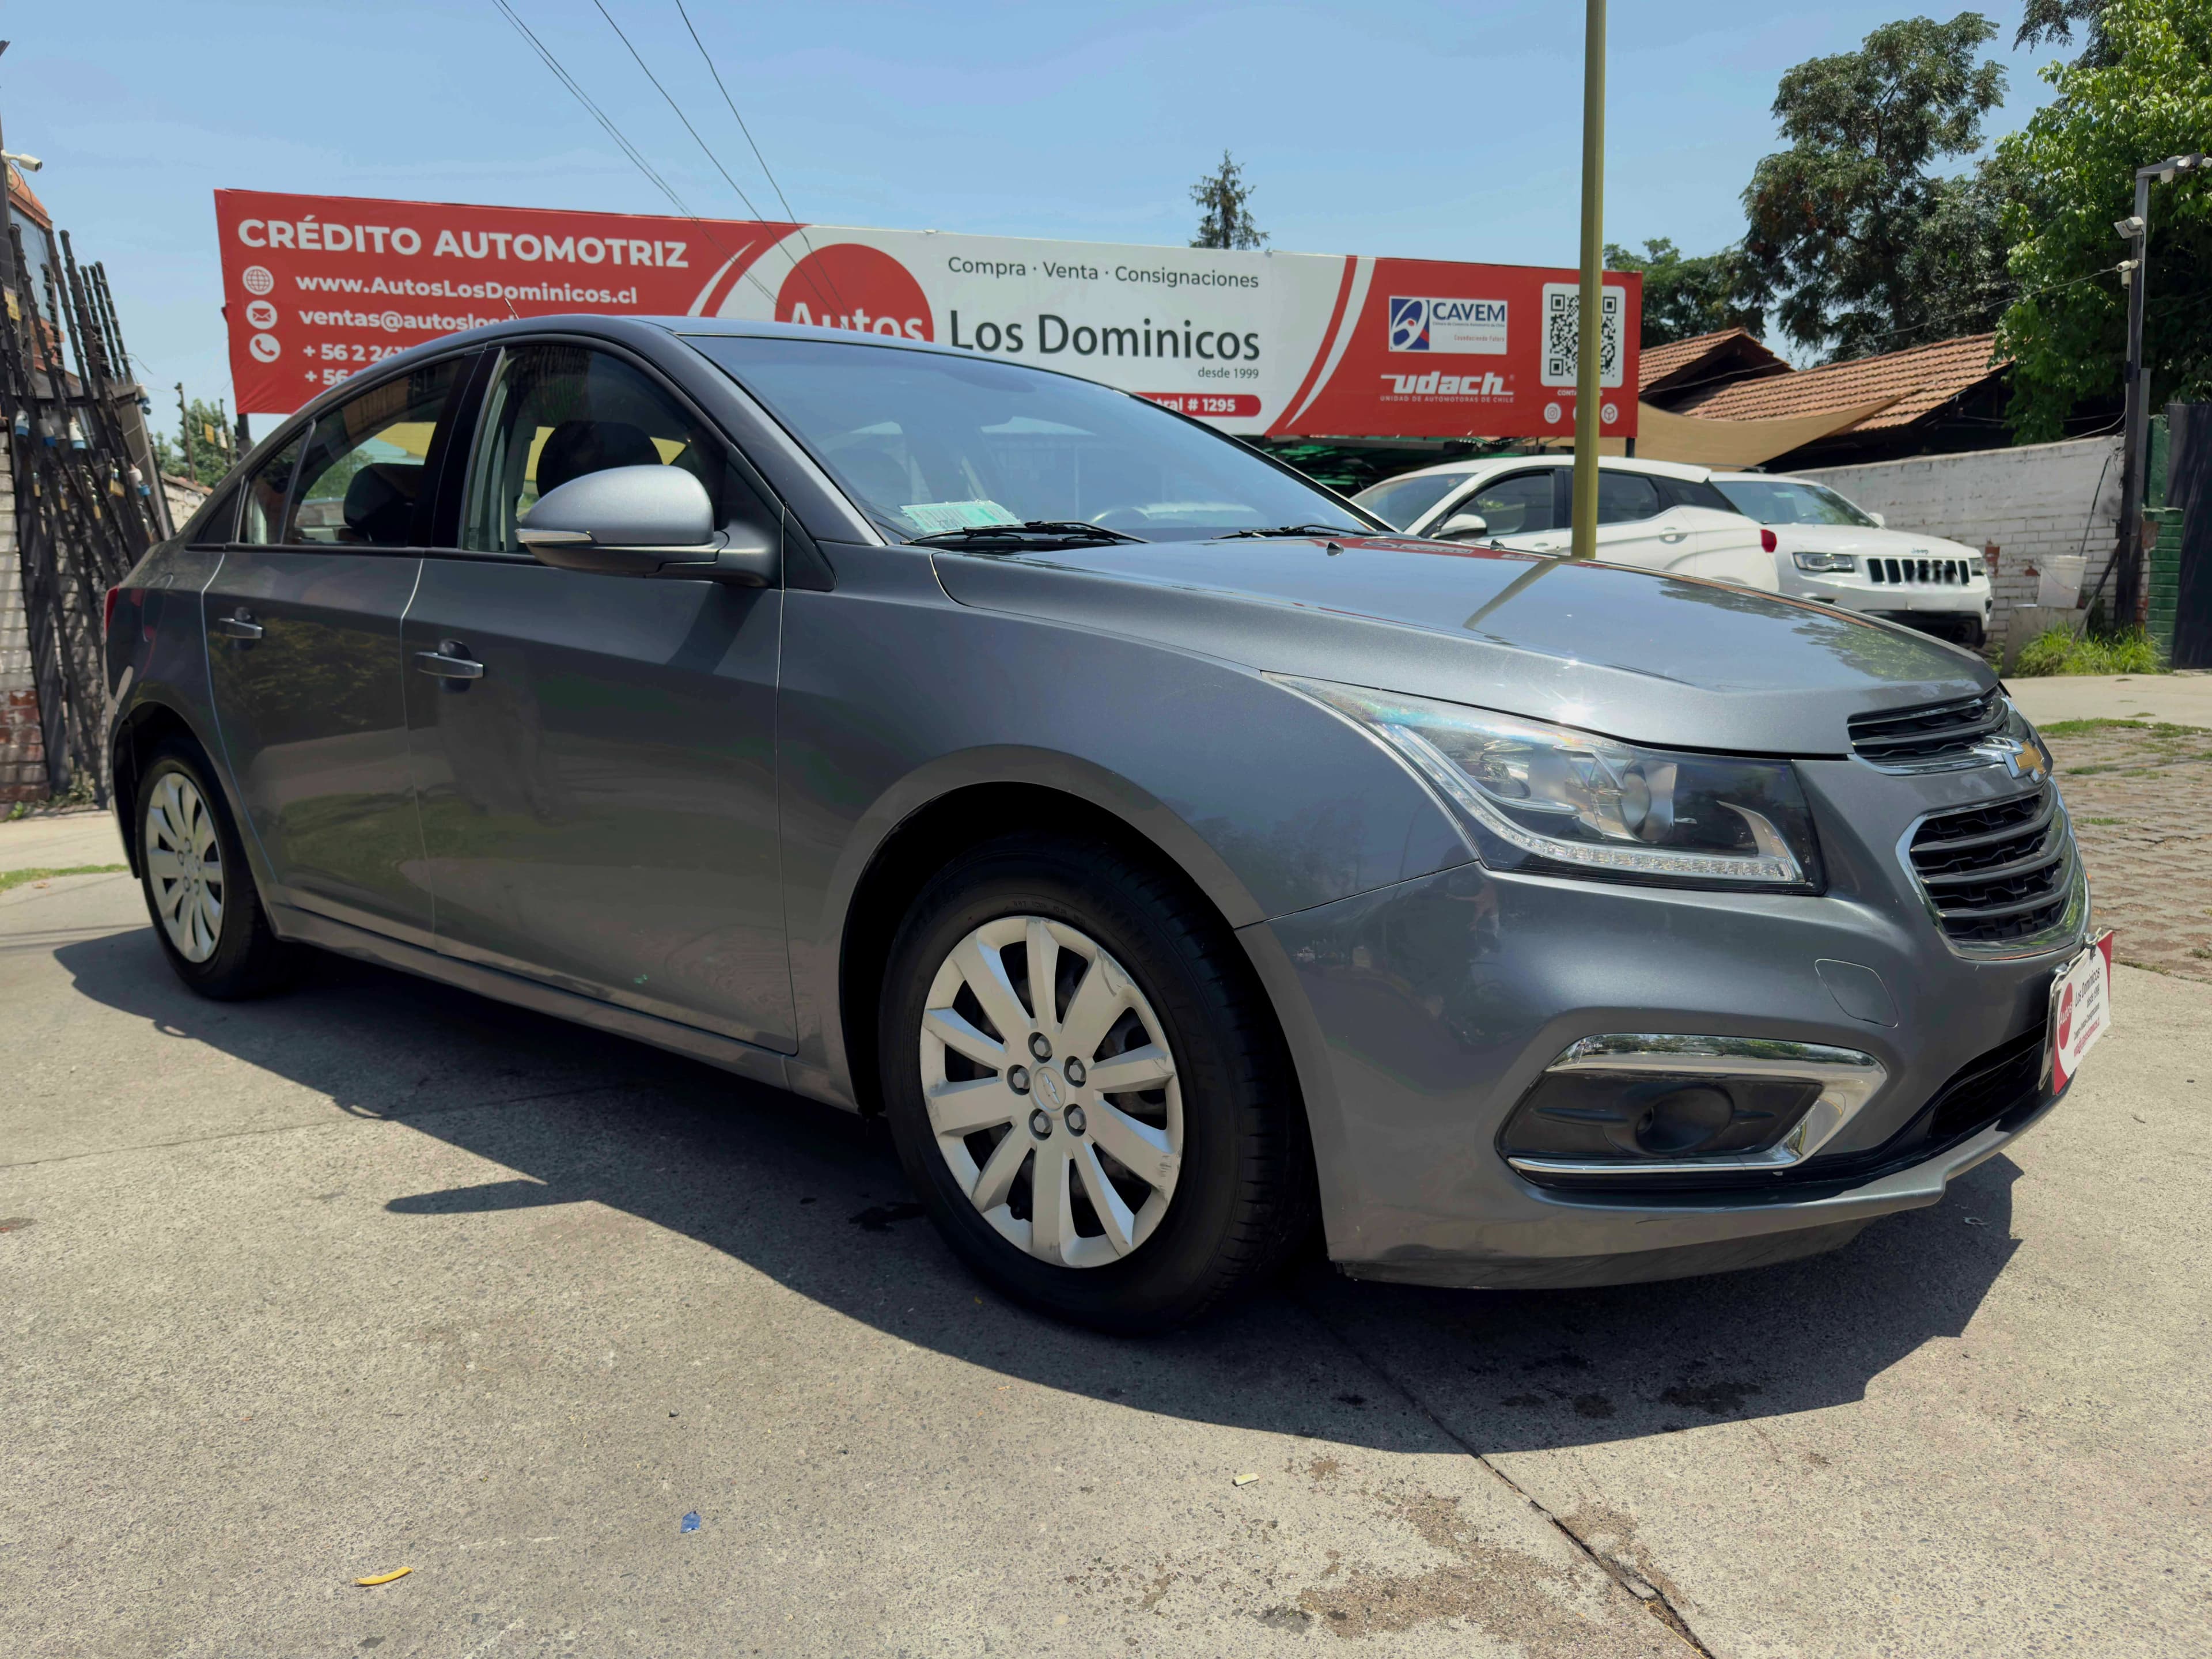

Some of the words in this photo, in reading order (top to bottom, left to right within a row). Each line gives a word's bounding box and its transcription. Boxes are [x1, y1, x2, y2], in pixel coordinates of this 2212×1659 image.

[238, 215, 422, 256] CRÉDITO
[433, 230, 689, 268] AUTOMOTRIZ
[948, 256, 1026, 278] Compra
[1043, 262, 1098, 280] Venta
[1115, 266, 1259, 288] Consignaciones
[295, 274, 637, 304] www.AutosLosDominicos.cl
[1433, 302, 1505, 321] CAVEM
[950, 310, 1024, 353] Los
[1039, 314, 1260, 361] Dominicos
[321, 344, 348, 361] 56
[351, 344, 366, 362] 2
[1198, 367, 1230, 378] desde
[1234, 369, 1259, 379] 1999
[1380, 371, 1514, 395] udach
[1202, 399, 1236, 412] 1295
